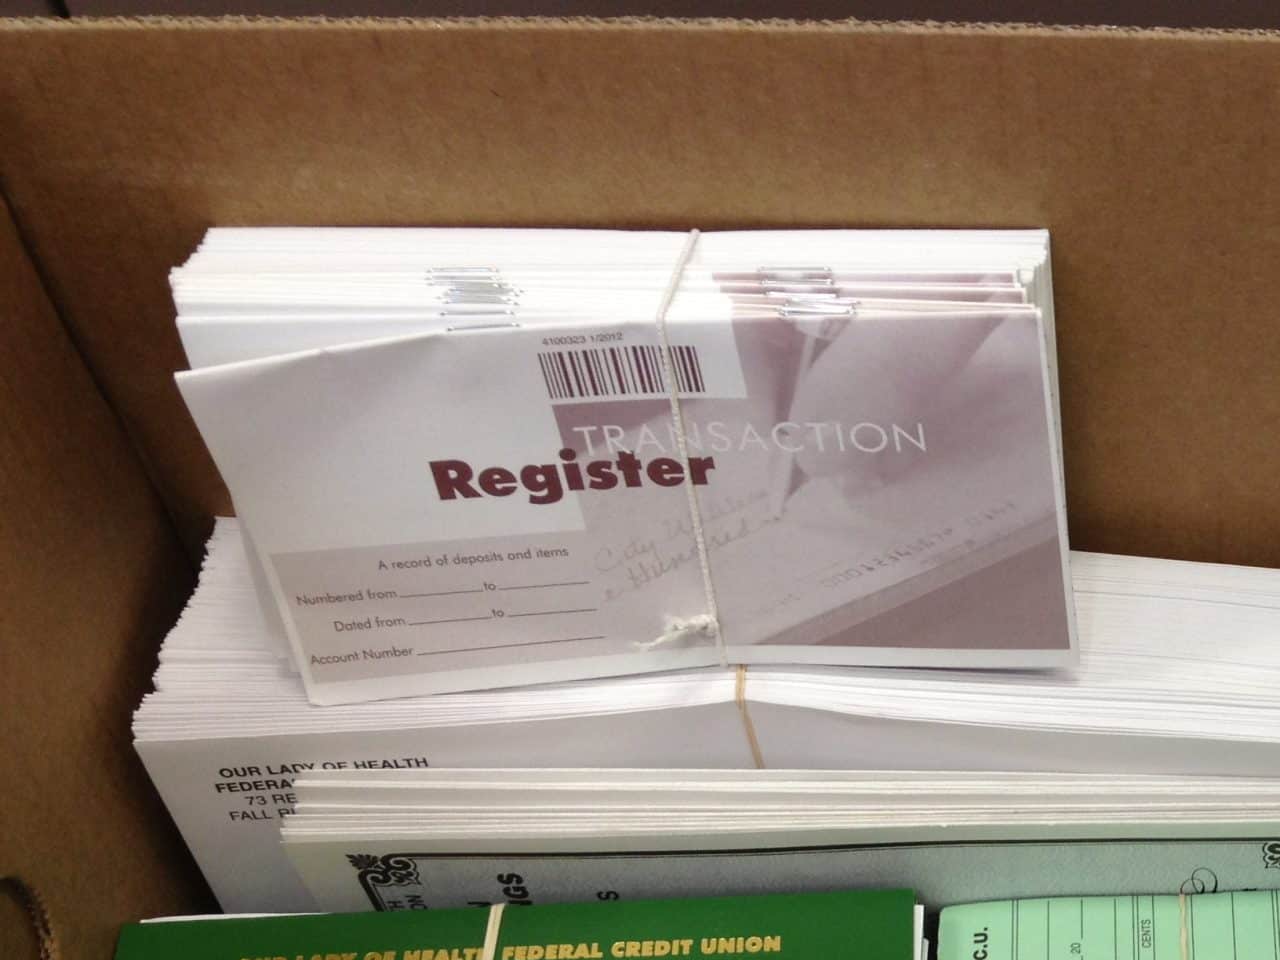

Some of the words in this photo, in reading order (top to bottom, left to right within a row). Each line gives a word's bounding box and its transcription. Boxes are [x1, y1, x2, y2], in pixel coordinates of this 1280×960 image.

[573, 422, 926, 457] TRANSACTION
[429, 448, 716, 505] Register
[392, 556, 432, 569] record
[436, 554, 448, 566] of
[453, 552, 503, 568] deposits
[507, 549, 532, 560] and
[536, 547, 568, 560] items
[296, 591, 364, 606] Numbered
[368, 588, 397, 600] from
[334, 618, 372, 632] Dated
[375, 616, 406, 628] from
[310, 652, 359, 666] Account
[363, 647, 414, 662] Number
[219, 766, 261, 778] OUR
[1142, 919, 1152, 948] CENTS
[611, 939, 694, 958] CREDIT
[700, 935, 782, 954] UNION
[1071, 942, 1082, 954] 20
